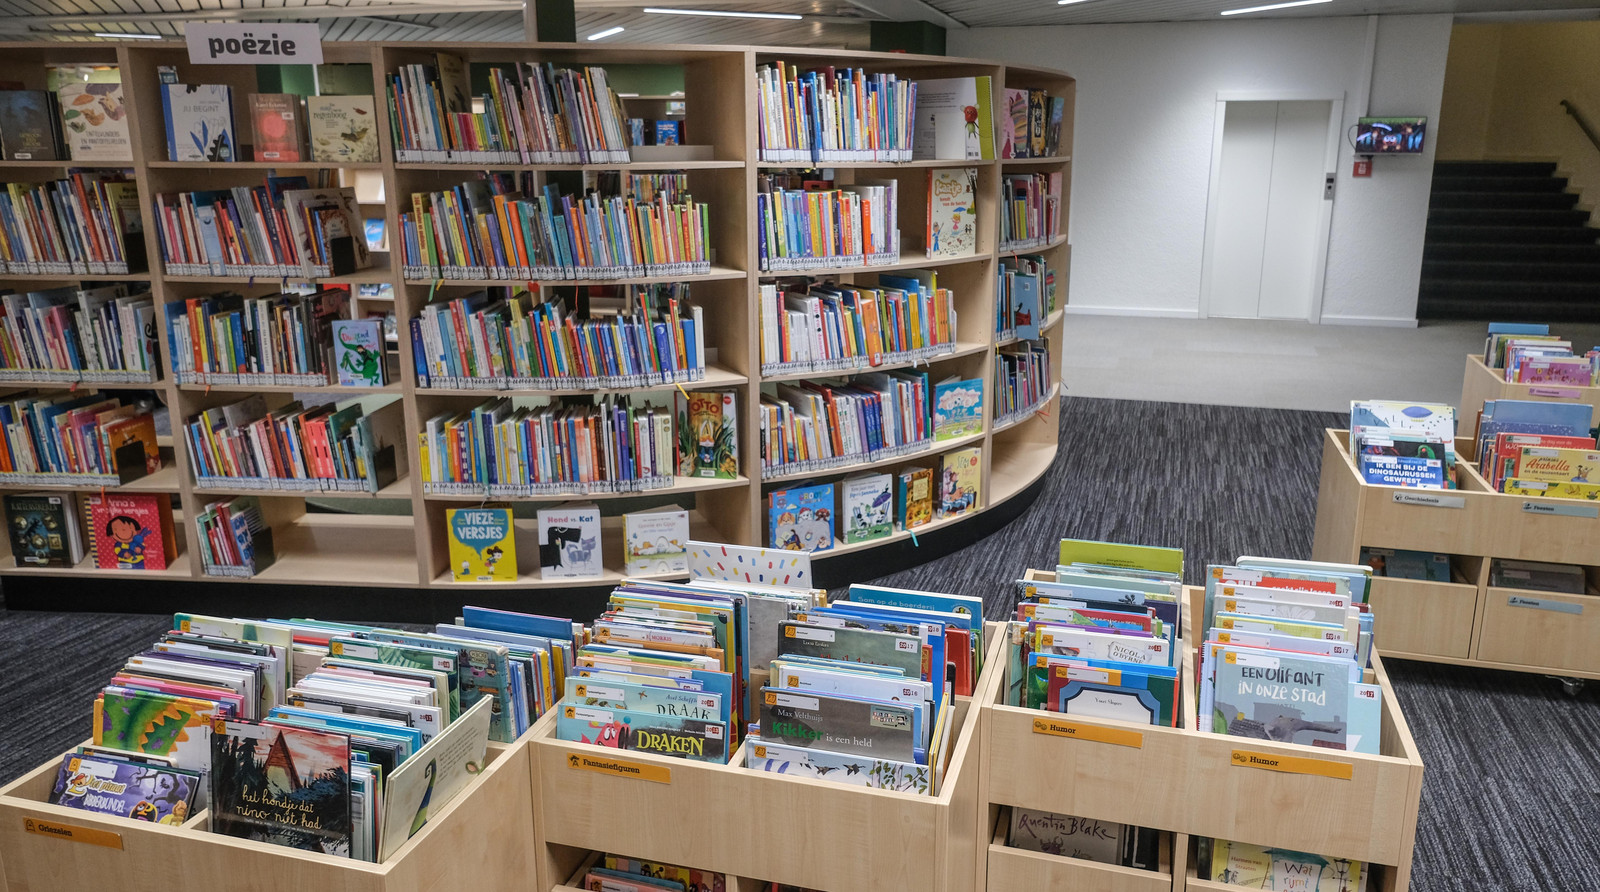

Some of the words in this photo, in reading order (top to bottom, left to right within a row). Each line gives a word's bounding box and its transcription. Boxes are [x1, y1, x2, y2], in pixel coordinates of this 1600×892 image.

[208, 32, 296, 58] poëzie
[691, 399, 720, 414] OTTO
[1526, 459, 1570, 471] Arabella
[1369, 468, 1436, 479] DINOSAURUSSEN
[1383, 476, 1421, 484] GEWEEST
[464, 512, 494, 525] VIEZE
[457, 526, 503, 540] VERSJES
[857, 596, 876, 605] Sam
[877, 599, 886, 607] op
[899, 601, 935, 612] boerderij
[1114, 645, 1146, 660] NICOLA
[1241, 666, 1264, 679] EEN
[656, 703, 711, 720] DRAAK
[777, 708, 793, 718] Max
[794, 711, 823, 722] Velthuijs
[772, 721, 824, 741] Kikker
[1049, 723, 1077, 734] Humor
[637, 729, 705, 756] DRAKEN
[826, 733, 833, 742] is
[835, 735, 850, 745] een
[853, 736, 873, 748] held
[583, 758, 641, 774] Fantasiefiguren
[1249, 755, 1279, 767] Humor
[242, 784, 261, 803] het
[262, 788, 298, 816] hondje
[299, 799, 314, 813] dat
[236, 804, 270, 819] nino
[274, 809, 298, 825] niet
[301, 813, 322, 830] had
[38, 823, 73, 837] Griezelen
[1018, 813, 1066, 838] Quentin
[1061, 818, 1117, 840] Blake
[1284, 862, 1313, 877] Wat
[1283, 875, 1309, 889] rijmt
